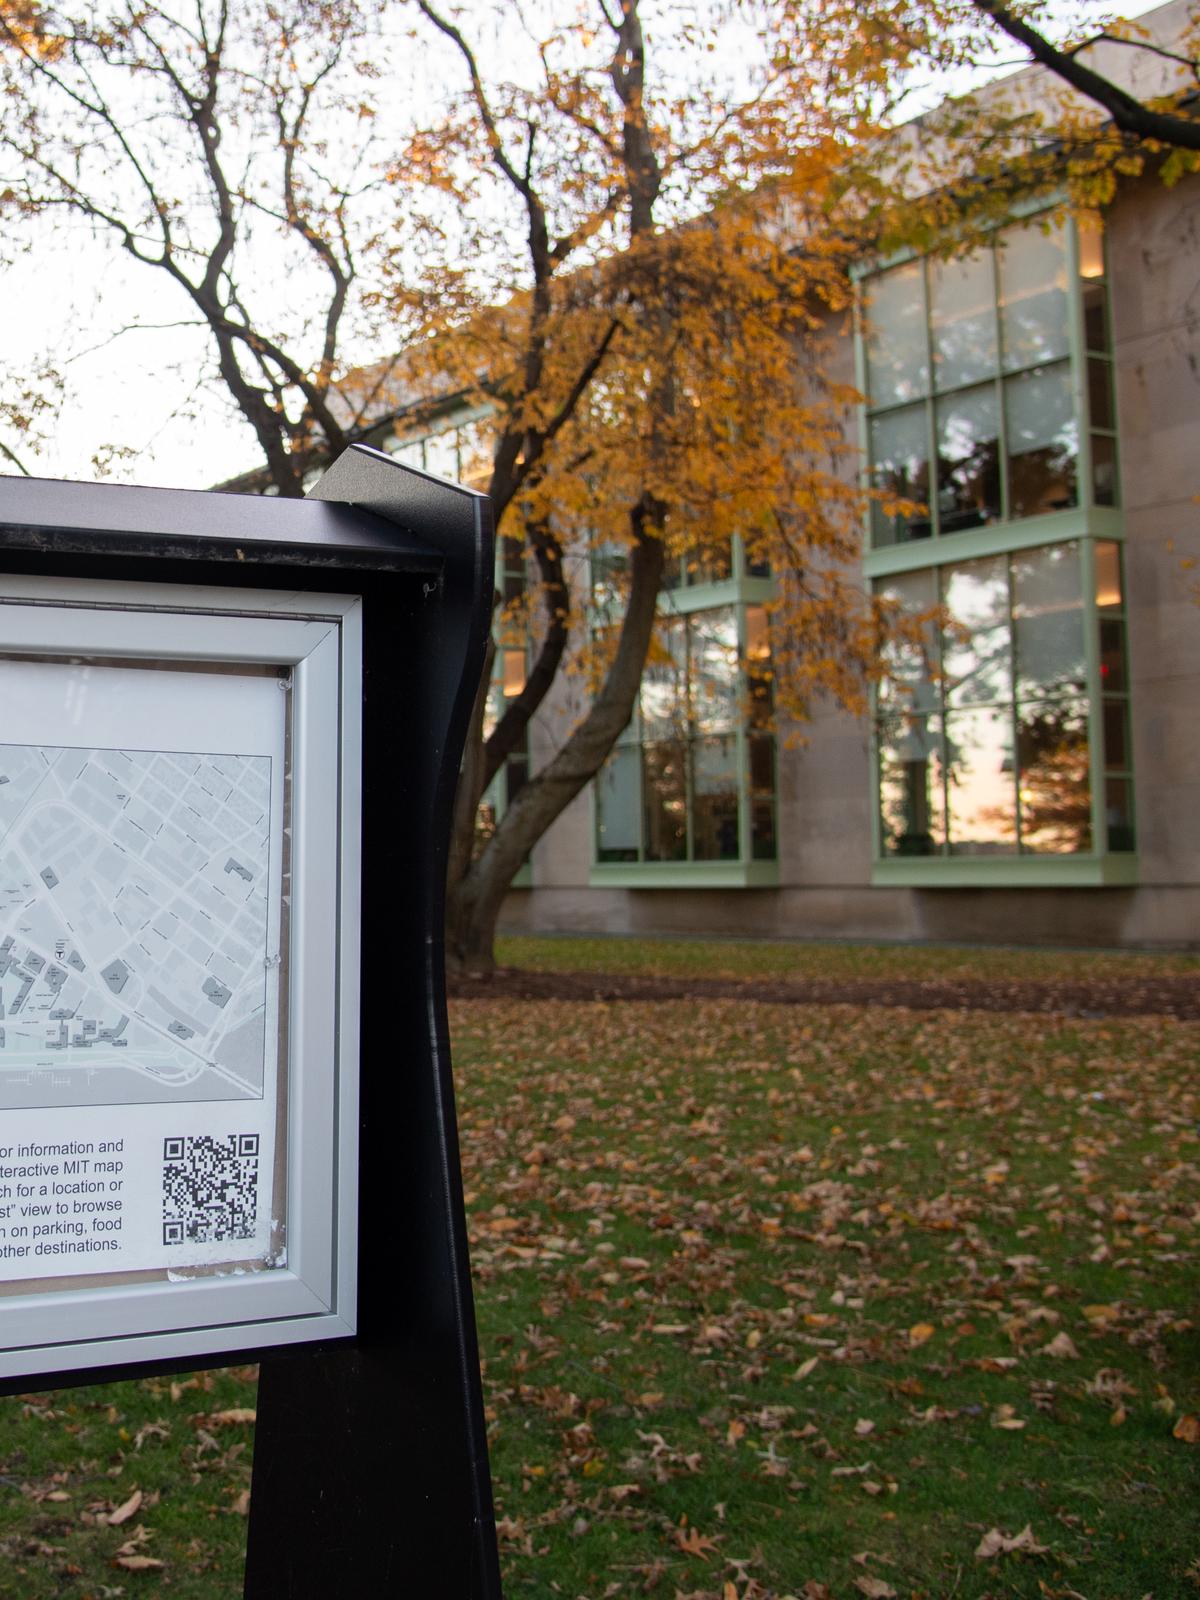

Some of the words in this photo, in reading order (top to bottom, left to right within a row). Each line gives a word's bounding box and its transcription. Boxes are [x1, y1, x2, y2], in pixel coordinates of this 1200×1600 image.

[17, 1141, 94, 1157] information
[98, 1138, 124, 1153] and
[63, 1159, 90, 1175] MIT
[94, 1161, 124, 1175] map
[16, 1183, 36, 1197] for
[39, 1185, 48, 1196] a
[52, 1179, 105, 1195] location
[109, 1180, 124, 1192] or
[20, 1203, 52, 1217] view
[55, 1202, 69, 1215] to
[73, 1200, 123, 1214] browse
[10, 1226, 28, 1238] on
[32, 1220, 88, 1239] parking,
[92, 1216, 122, 1232] food
[34, 1238, 122, 1256] destinations.
